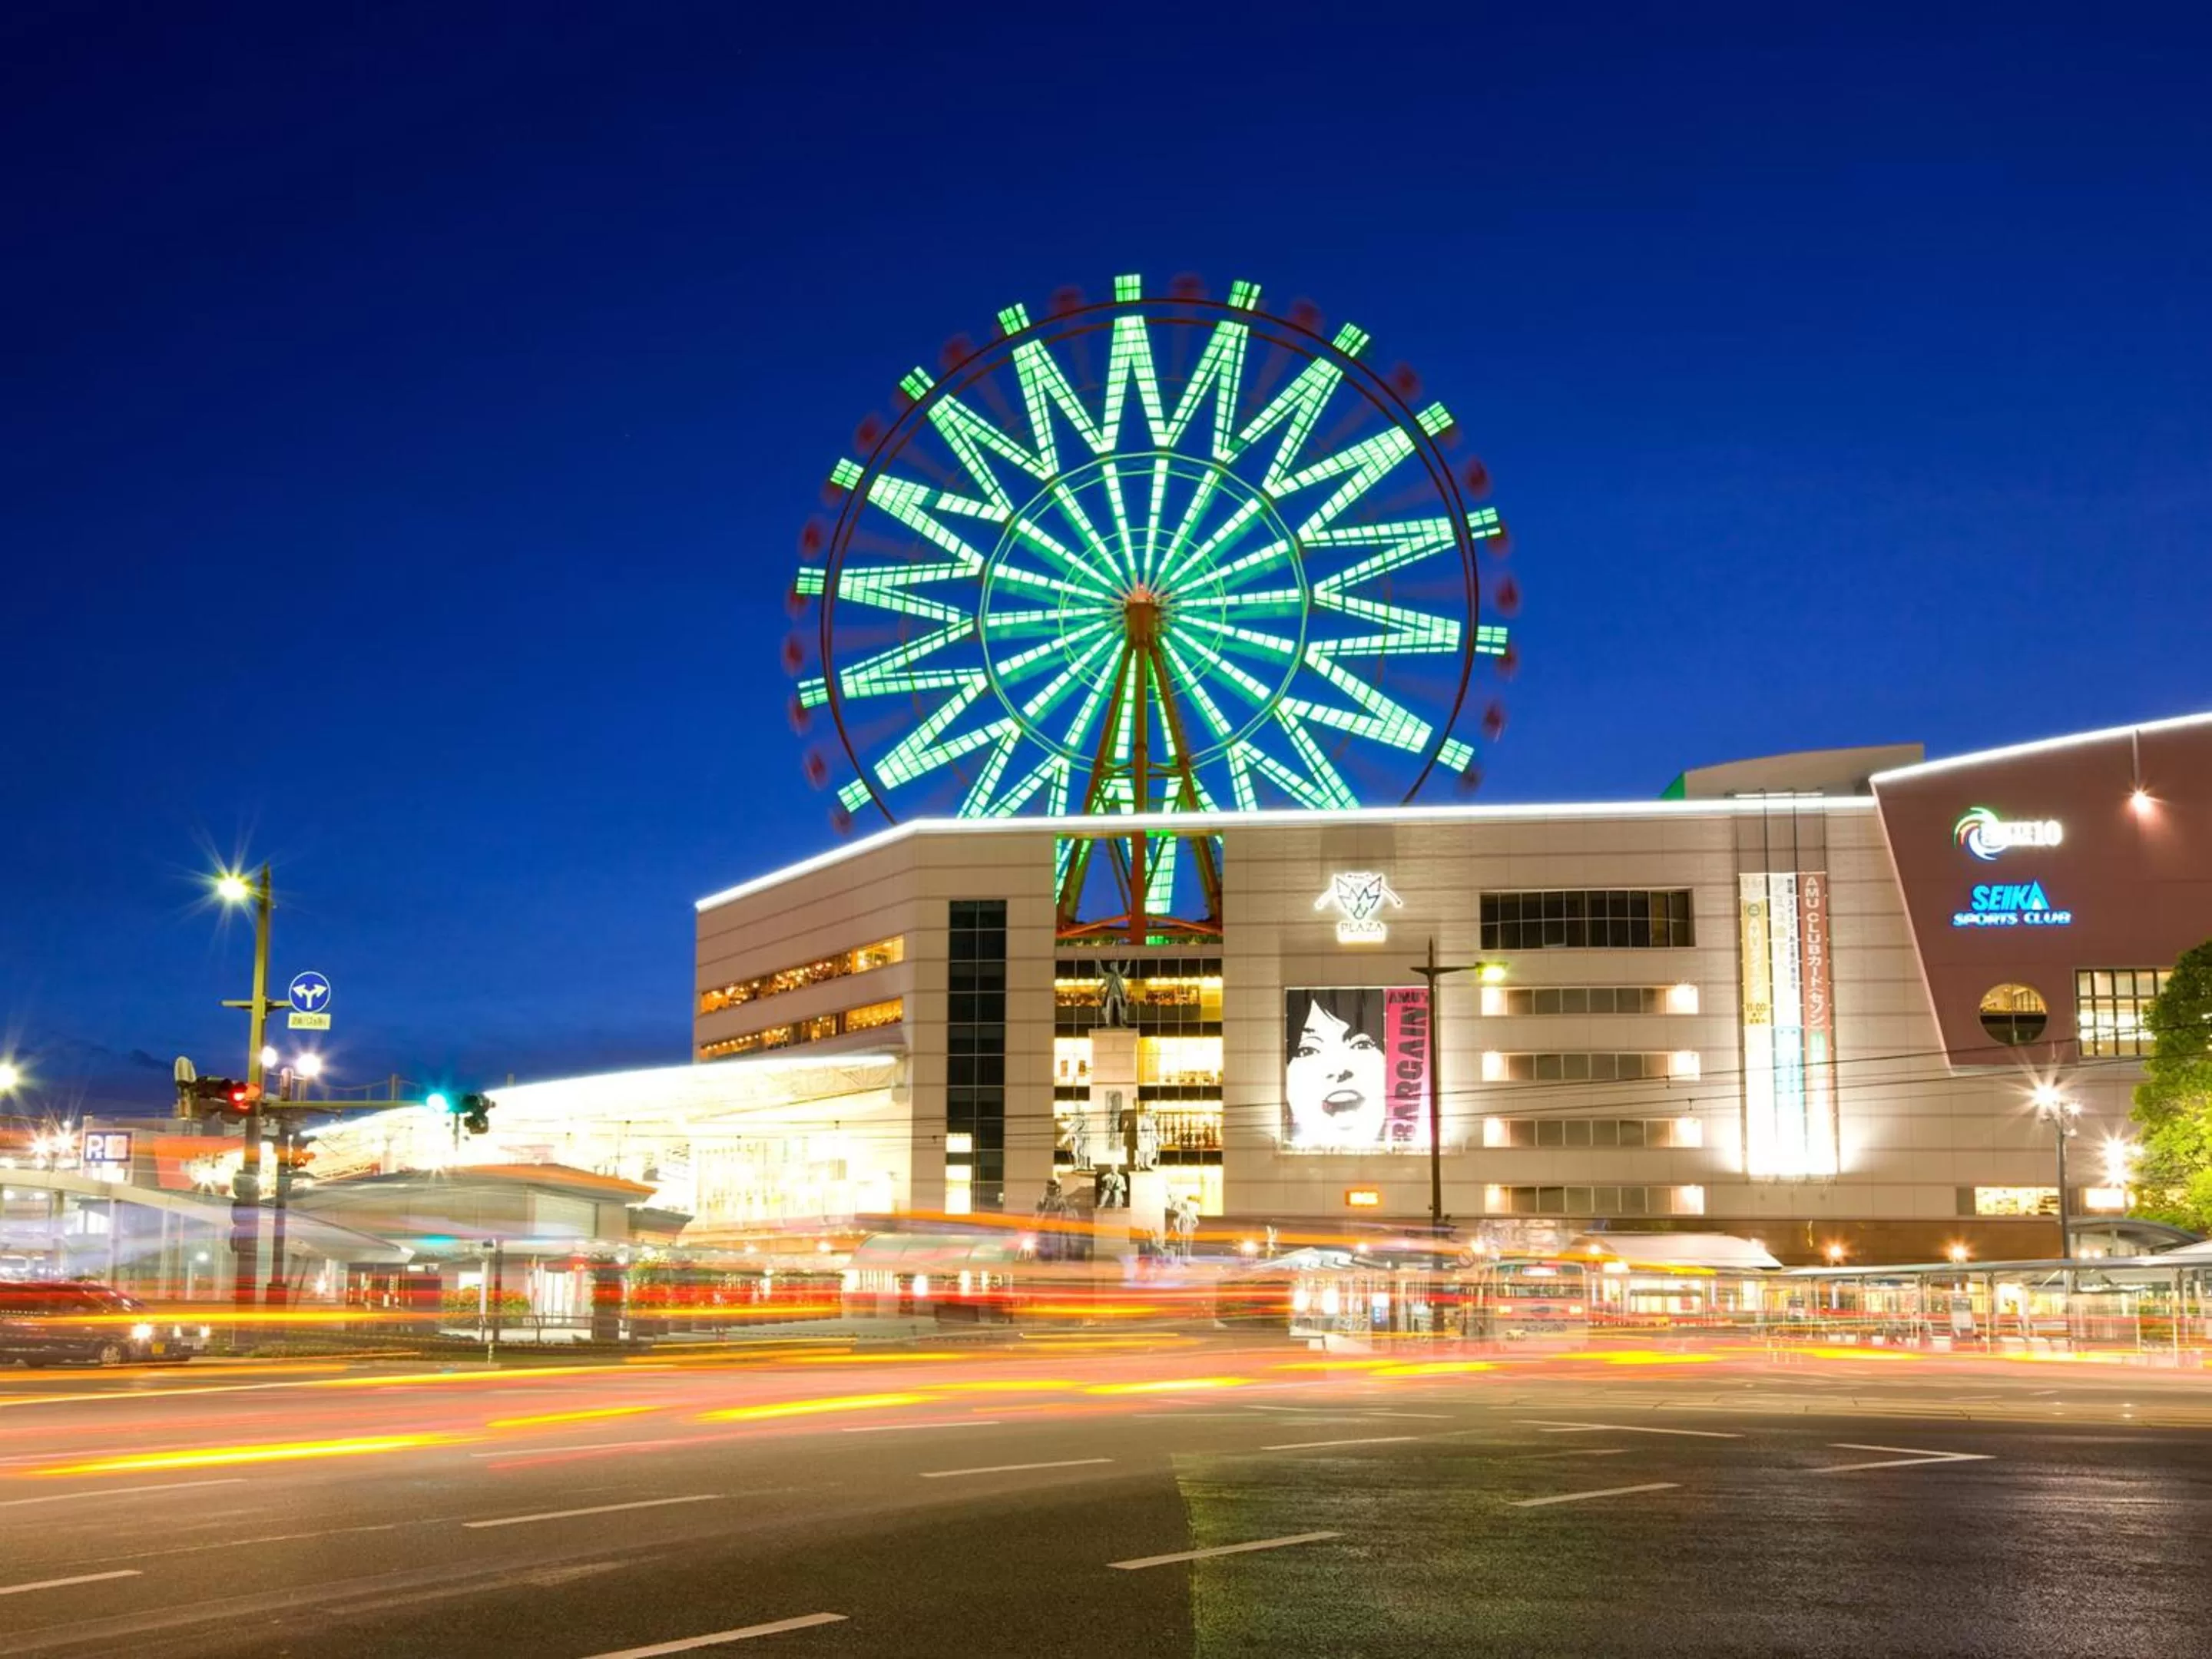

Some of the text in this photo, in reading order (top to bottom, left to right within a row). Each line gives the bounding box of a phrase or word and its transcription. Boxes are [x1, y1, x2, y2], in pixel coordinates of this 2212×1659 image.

[1971, 879, 2050, 911] SEIKA
[1341, 922, 1383, 932] PLAZA
[1952, 912, 2071, 926] SPORTS CLUB
[1392, 1006, 1427, 1142] BARGAIN
